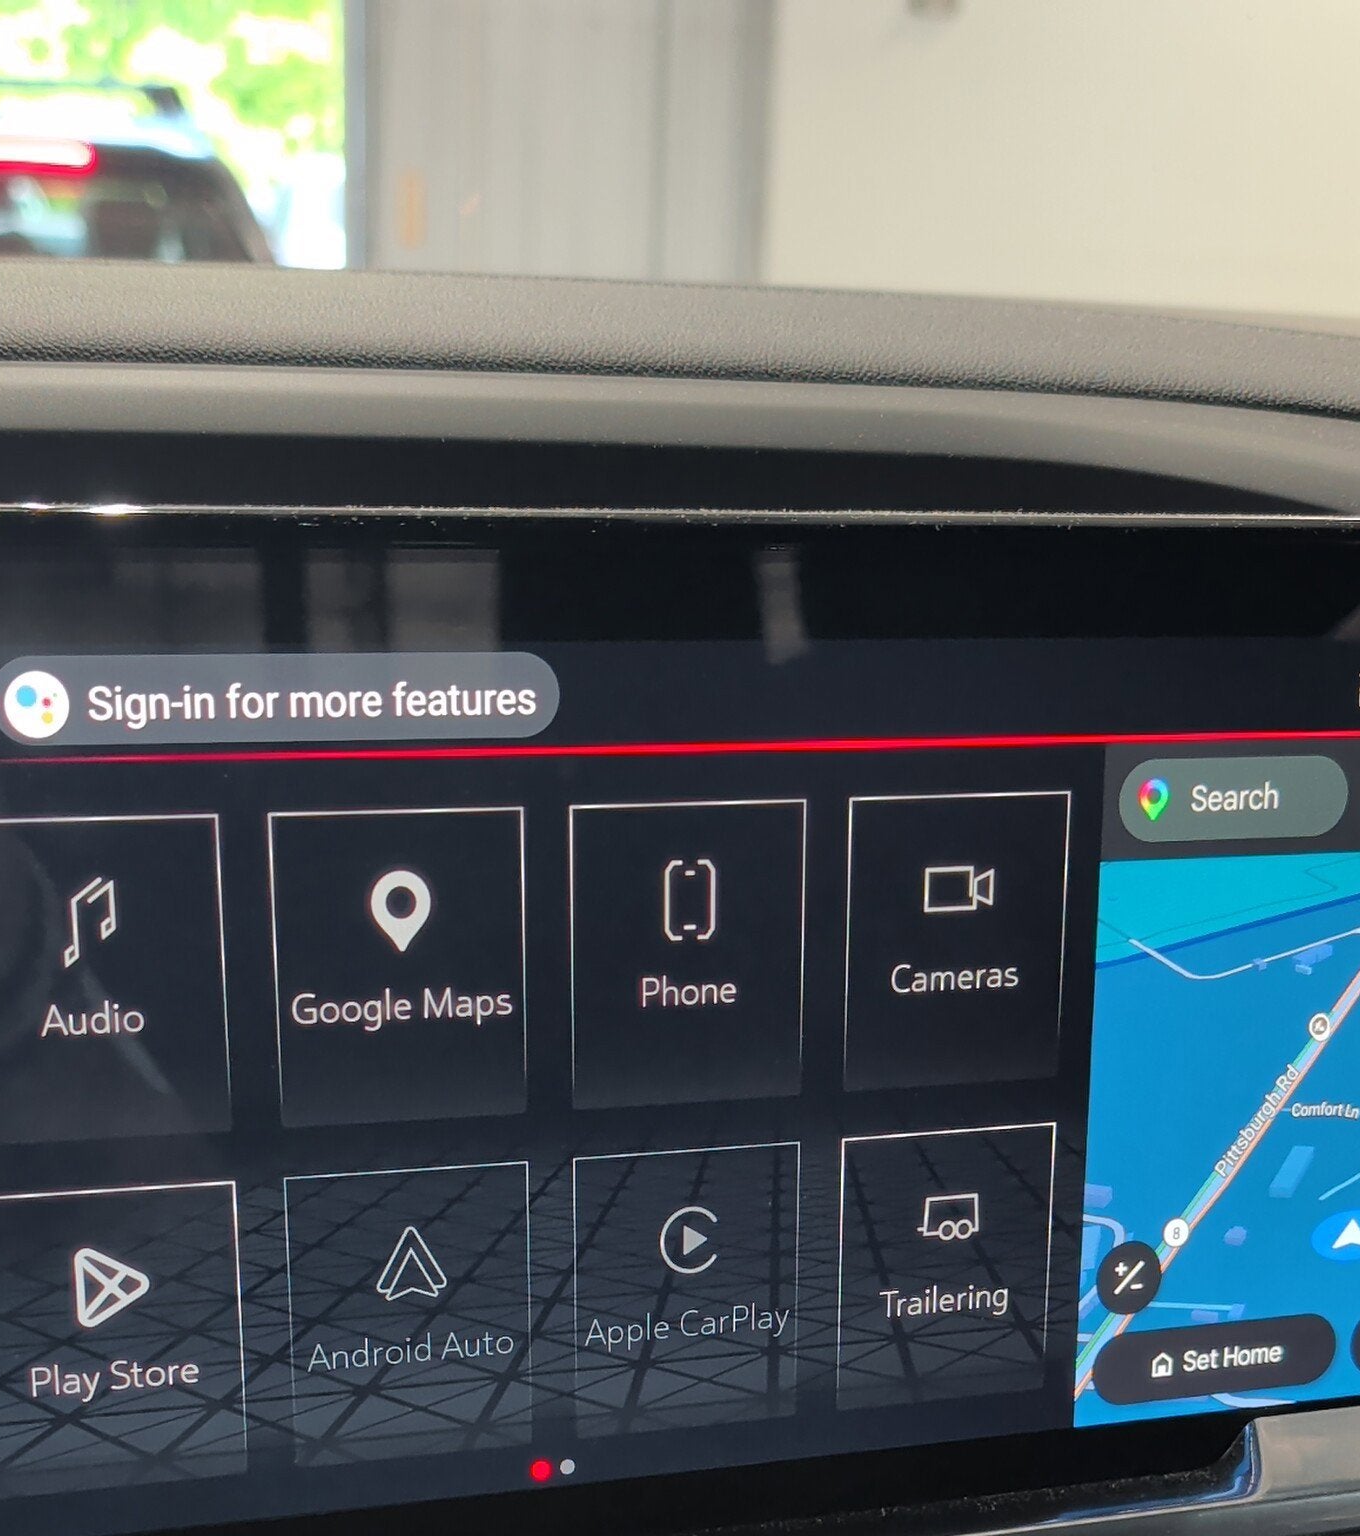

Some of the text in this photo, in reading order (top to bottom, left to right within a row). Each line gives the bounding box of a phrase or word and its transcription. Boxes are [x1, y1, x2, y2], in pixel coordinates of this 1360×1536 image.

[87, 681, 537, 730] Sign-in for more features
[1189, 780, 1280, 814] Search
[641, 974, 738, 1008] Phone
[890, 963, 1019, 994] Cameras
[40, 1001, 145, 1037] Audio
[291, 987, 513, 1031] Google Maps
[1214, 1063, 1300, 1178] Pittsburgh Rd
[1290, 1101, 1360, 1119] Comfort Ln
[879, 1284, 1010, 1319] Trailering
[584, 1302, 791, 1352] Apple CarPlay
[307, 1330, 515, 1373] Android Auto
[1182, 1344, 1284, 1372] Set Home
[31, 1359, 199, 1403] Play Store
